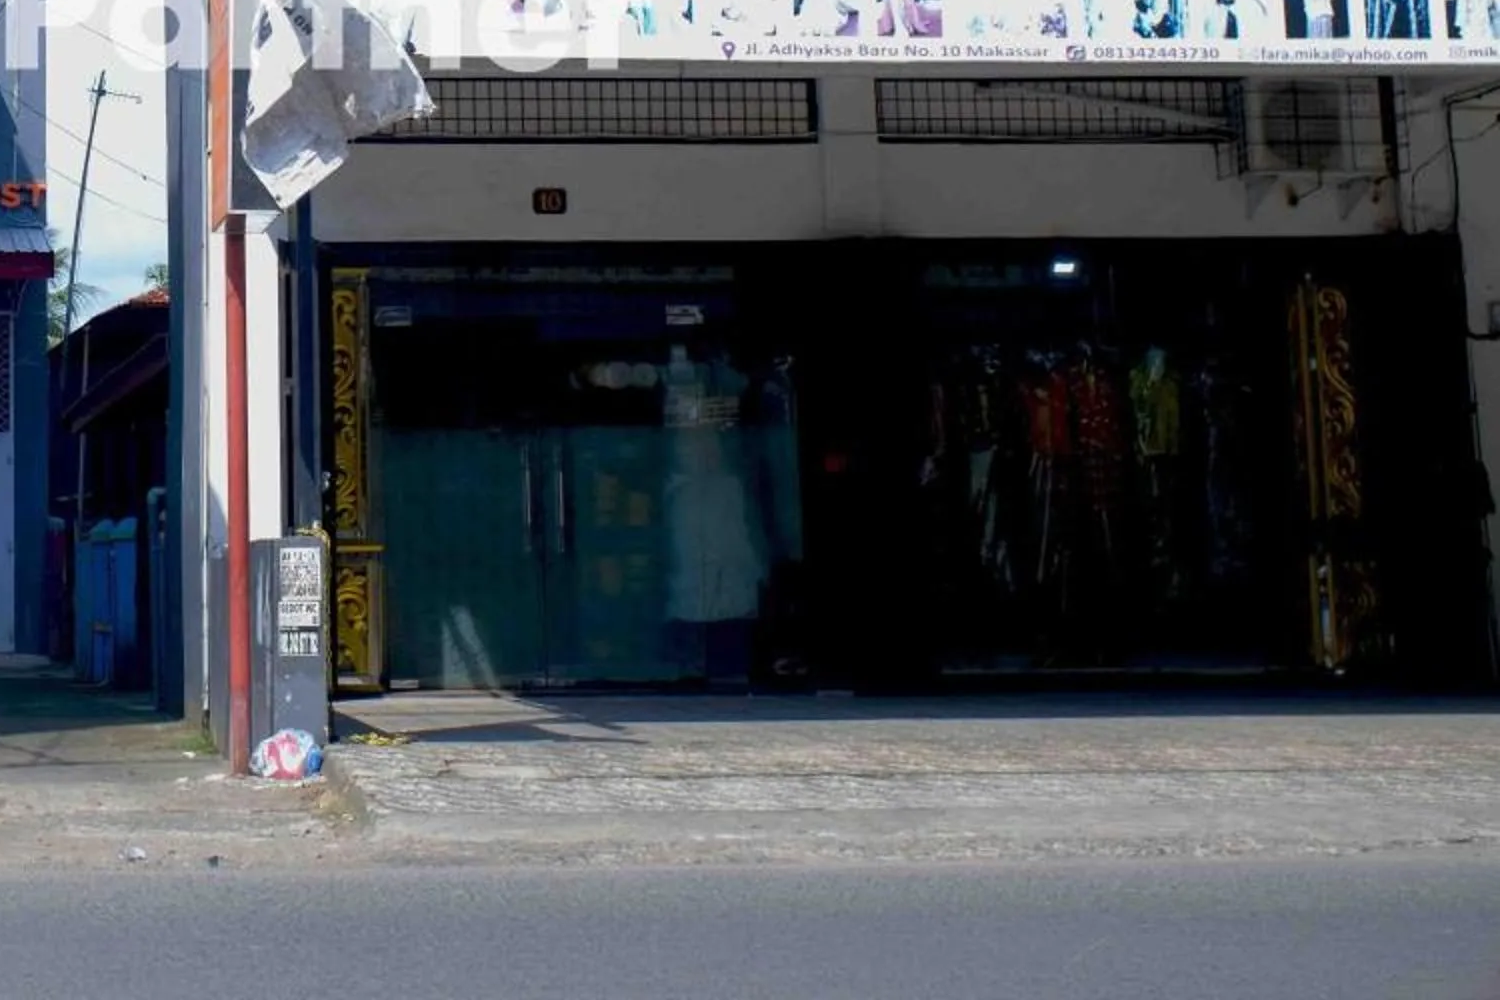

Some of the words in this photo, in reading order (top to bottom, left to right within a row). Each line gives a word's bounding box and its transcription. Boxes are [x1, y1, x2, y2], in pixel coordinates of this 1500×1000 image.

[769, 42, 852, 58] Adhyaksa
[858, 43, 899, 57] Baru
[904, 44, 934, 57] No.
[941, 44, 961, 57] 10
[966, 44, 1049, 58] Makassar
